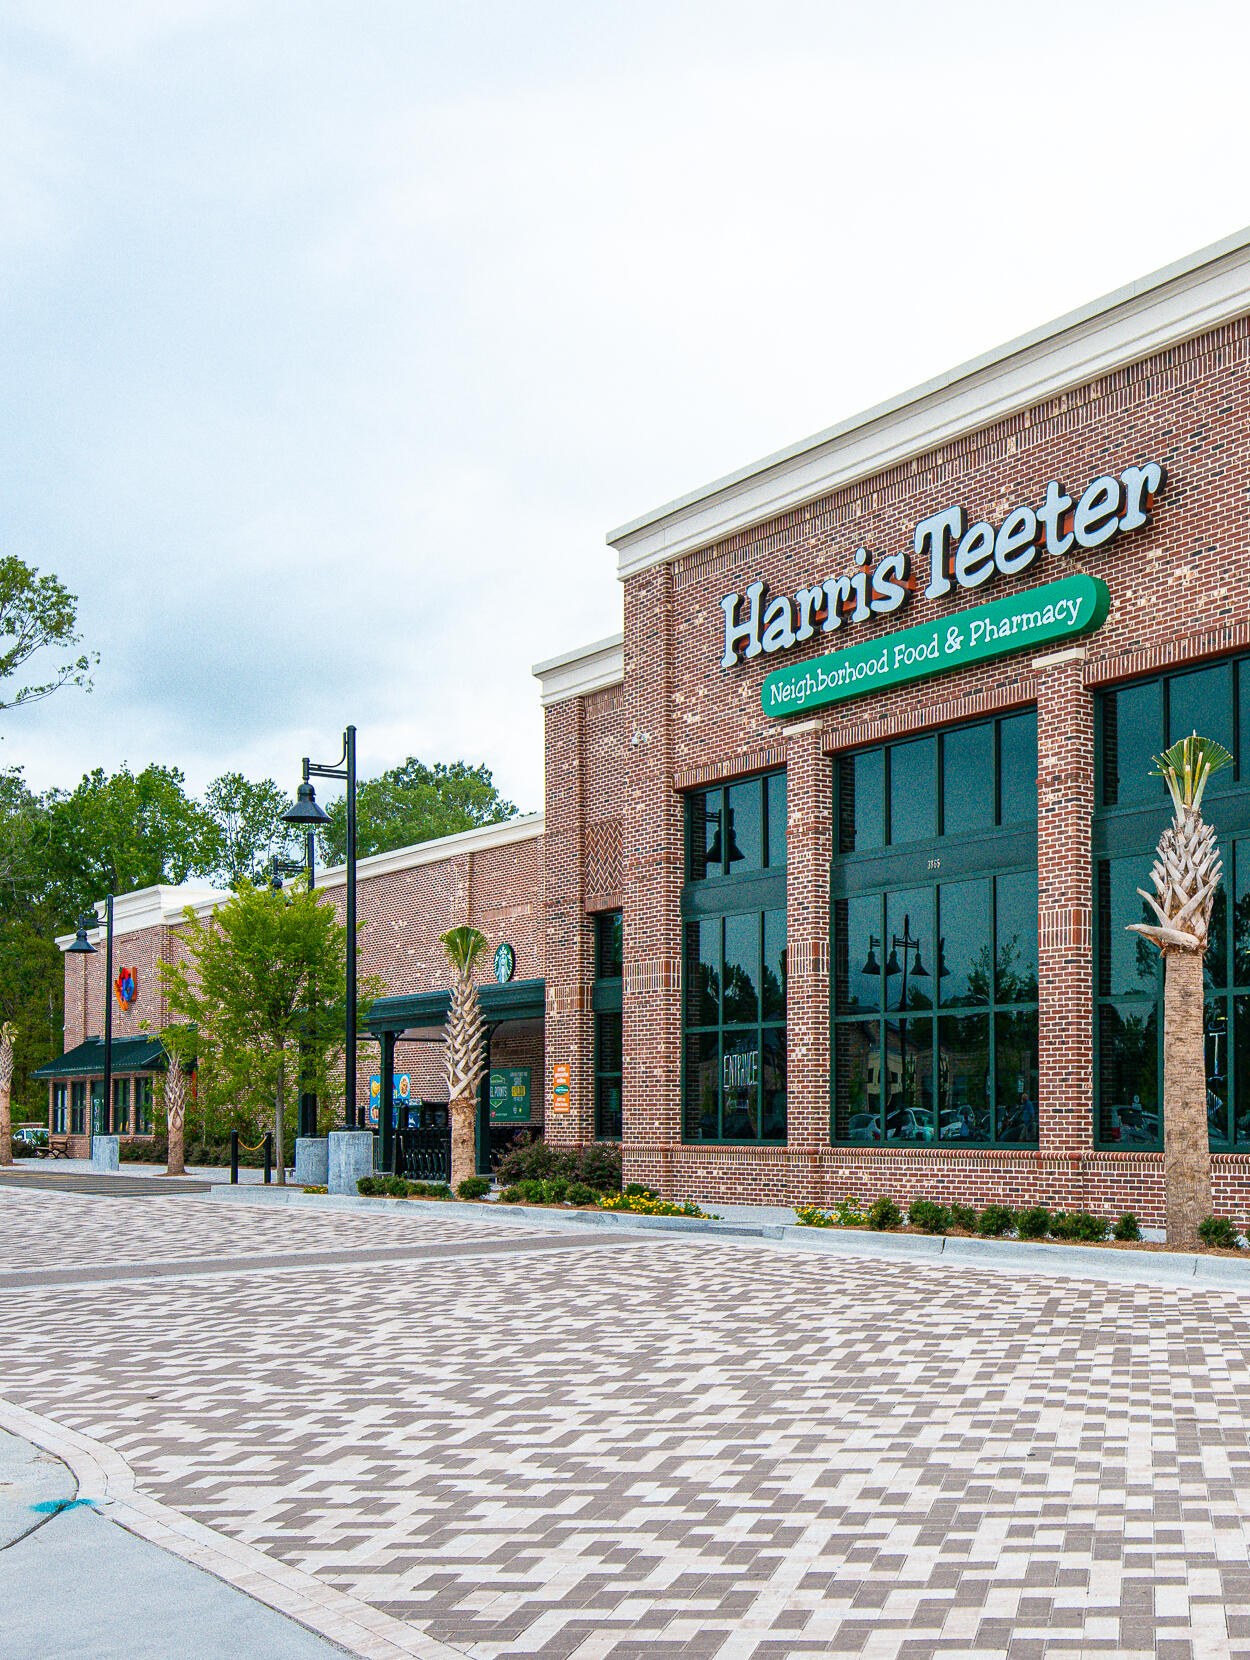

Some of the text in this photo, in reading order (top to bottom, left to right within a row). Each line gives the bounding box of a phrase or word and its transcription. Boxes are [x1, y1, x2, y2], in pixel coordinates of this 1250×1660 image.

[720, 461, 1166, 669] Harris Teeter
[769, 595, 1083, 706] Neighborhood Food & Pharmacy
[723, 1050, 759, 1088] ENTRANCE
